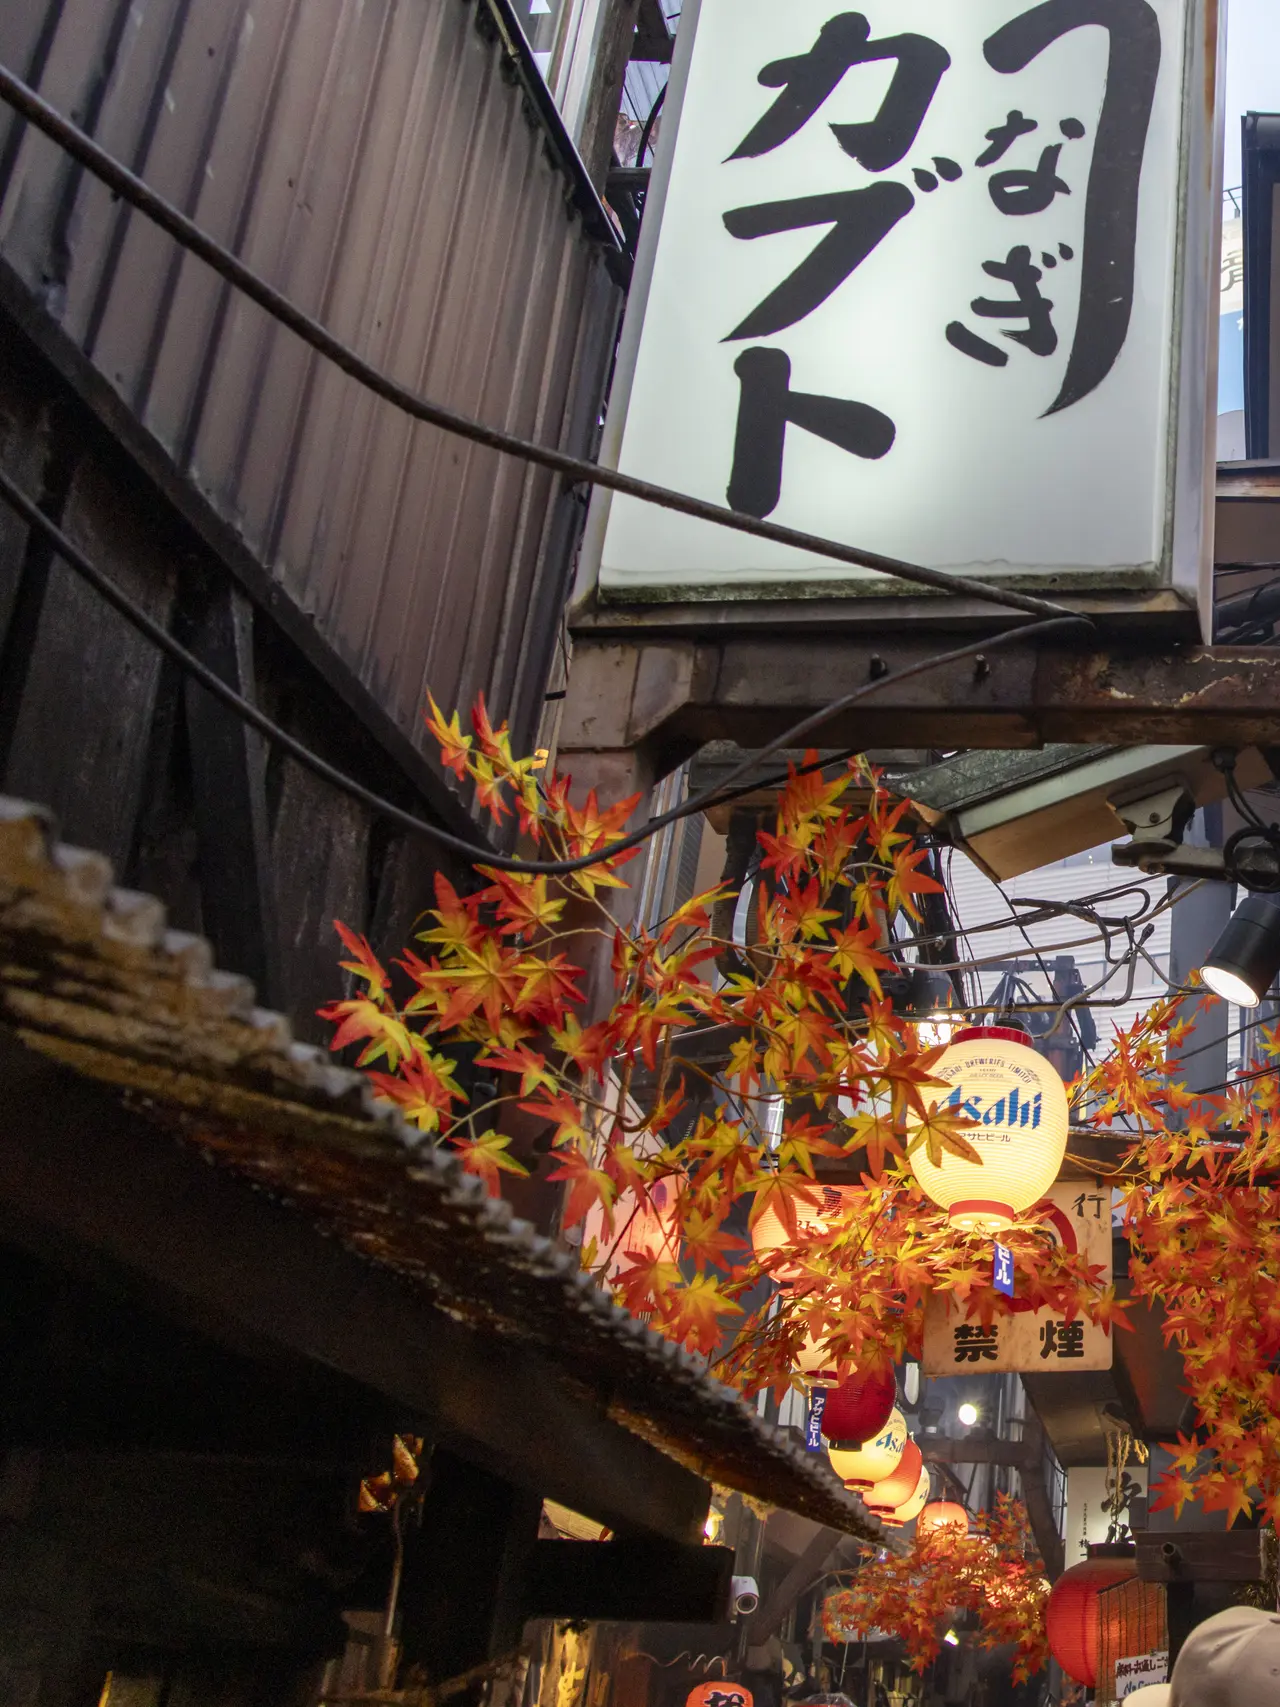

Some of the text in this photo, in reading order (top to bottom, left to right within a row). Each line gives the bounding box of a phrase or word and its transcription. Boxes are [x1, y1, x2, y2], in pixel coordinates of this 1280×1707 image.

[718, 11, 963, 520] カブト
[936, 1084, 1042, 1130] Asahi
[1071, 1192, 1107, 1219] 行
[807, 1396, 825, 1448] アサヒビール
